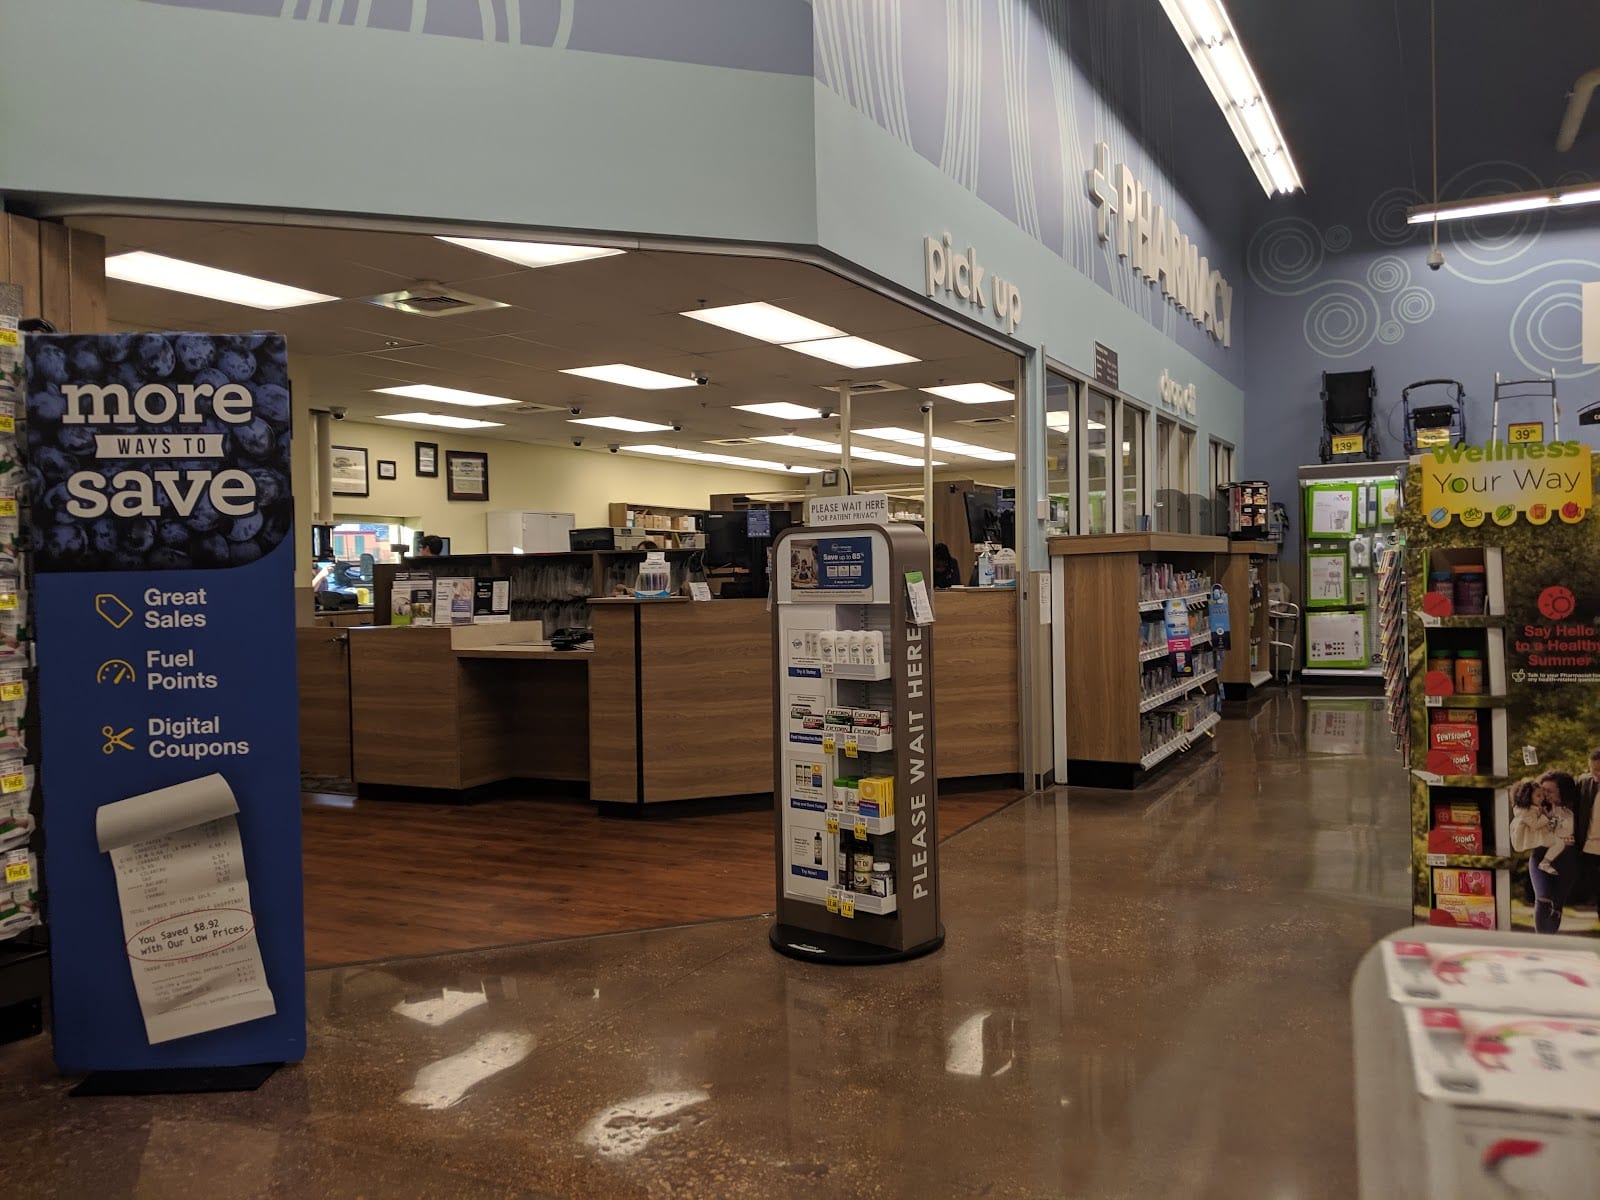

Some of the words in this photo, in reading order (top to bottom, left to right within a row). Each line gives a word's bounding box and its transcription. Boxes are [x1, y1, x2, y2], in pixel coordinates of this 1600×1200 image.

[1119, 163, 1232, 348] PHARMACY
[924, 232, 985, 308] pick
[992, 275, 1022, 334] up
[61, 383, 253, 424] more
[117, 438, 171, 455] WAYS
[183, 437, 206, 454] TO
[1431, 439, 1580, 464] Wellness
[1433, 473, 1502, 494] Your
[1512, 468, 1581, 492] Way
[65, 469, 257, 518] save
[811, 504, 839, 514] PLEASE
[842, 502, 862, 512] WAIT
[865, 500, 885, 510] HERE
[853, 512, 878, 520] PRIVACY
[144, 588, 207, 606] Great
[144, 610, 206, 629] Sales
[1524, 625, 1551, 641] Say
[1556, 625, 1595, 637] Hello
[1515, 640, 1533, 652] to
[1536, 642, 1545, 652] a
[147, 649, 194, 668] Fuel
[906, 628, 923, 698] HERE
[1528, 655, 1592, 667] Summer
[147, 672, 218, 690] Points
[149, 716, 219, 739] Digital
[149, 740, 250, 760] Coupons
[909, 711, 926, 783] WAIT
[910, 794, 929, 900] PLEASE
[138, 936, 156, 946] You
[161, 927, 189, 941] Saved
[194, 919, 219, 933] $8.92
[140, 944, 163, 956] with
[167, 939, 185, 950] Our
[190, 934, 208, 945] Low
[213, 924, 249, 938] Prices.
